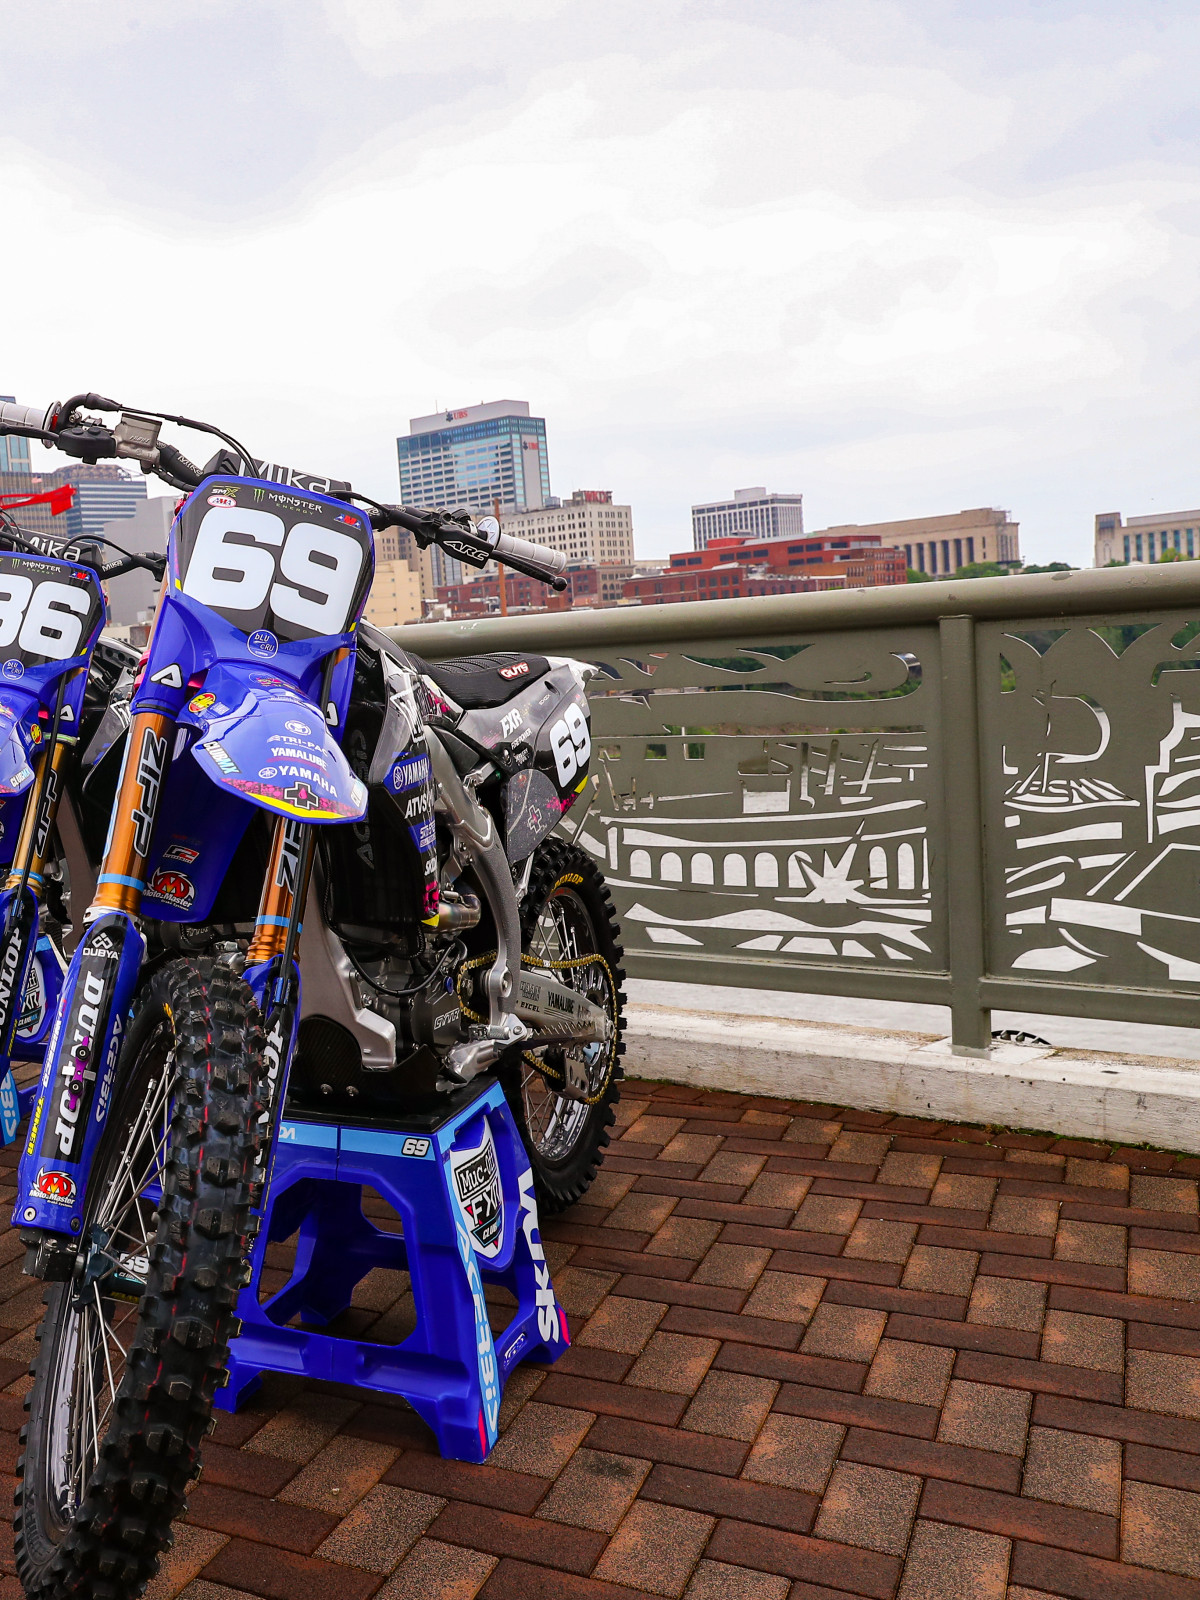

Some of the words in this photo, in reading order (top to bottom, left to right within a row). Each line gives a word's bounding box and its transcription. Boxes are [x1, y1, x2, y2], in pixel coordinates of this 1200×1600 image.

[453, 410, 468, 420] UBS
[239, 457, 331, 495] Mika
[211, 485, 241, 498] SMX
[268, 493, 323, 513] MONSTER
[443, 540, 490, 562] ARC
[22, 561, 62, 573] MONSTER
[183, 505, 363, 636] 69
[500, 662, 529, 678] GUTS
[499, 708, 524, 739] FXR
[280, 735, 329, 757] TRI-PAC
[550, 702, 592, 788] 69
[203, 741, 240, 775] CLUBMX
[271, 747, 329, 771] YAMALUBE
[278, 765, 338, 798] YAMAHA
[83, 947, 119, 960] DUBYA
[520, 1001, 540, 1012] EXCEL
[547, 991, 575, 1014] YAMALUBE
[402, 1139, 430, 1156] 69
[455, 1221, 498, 1433] ACERBIS
